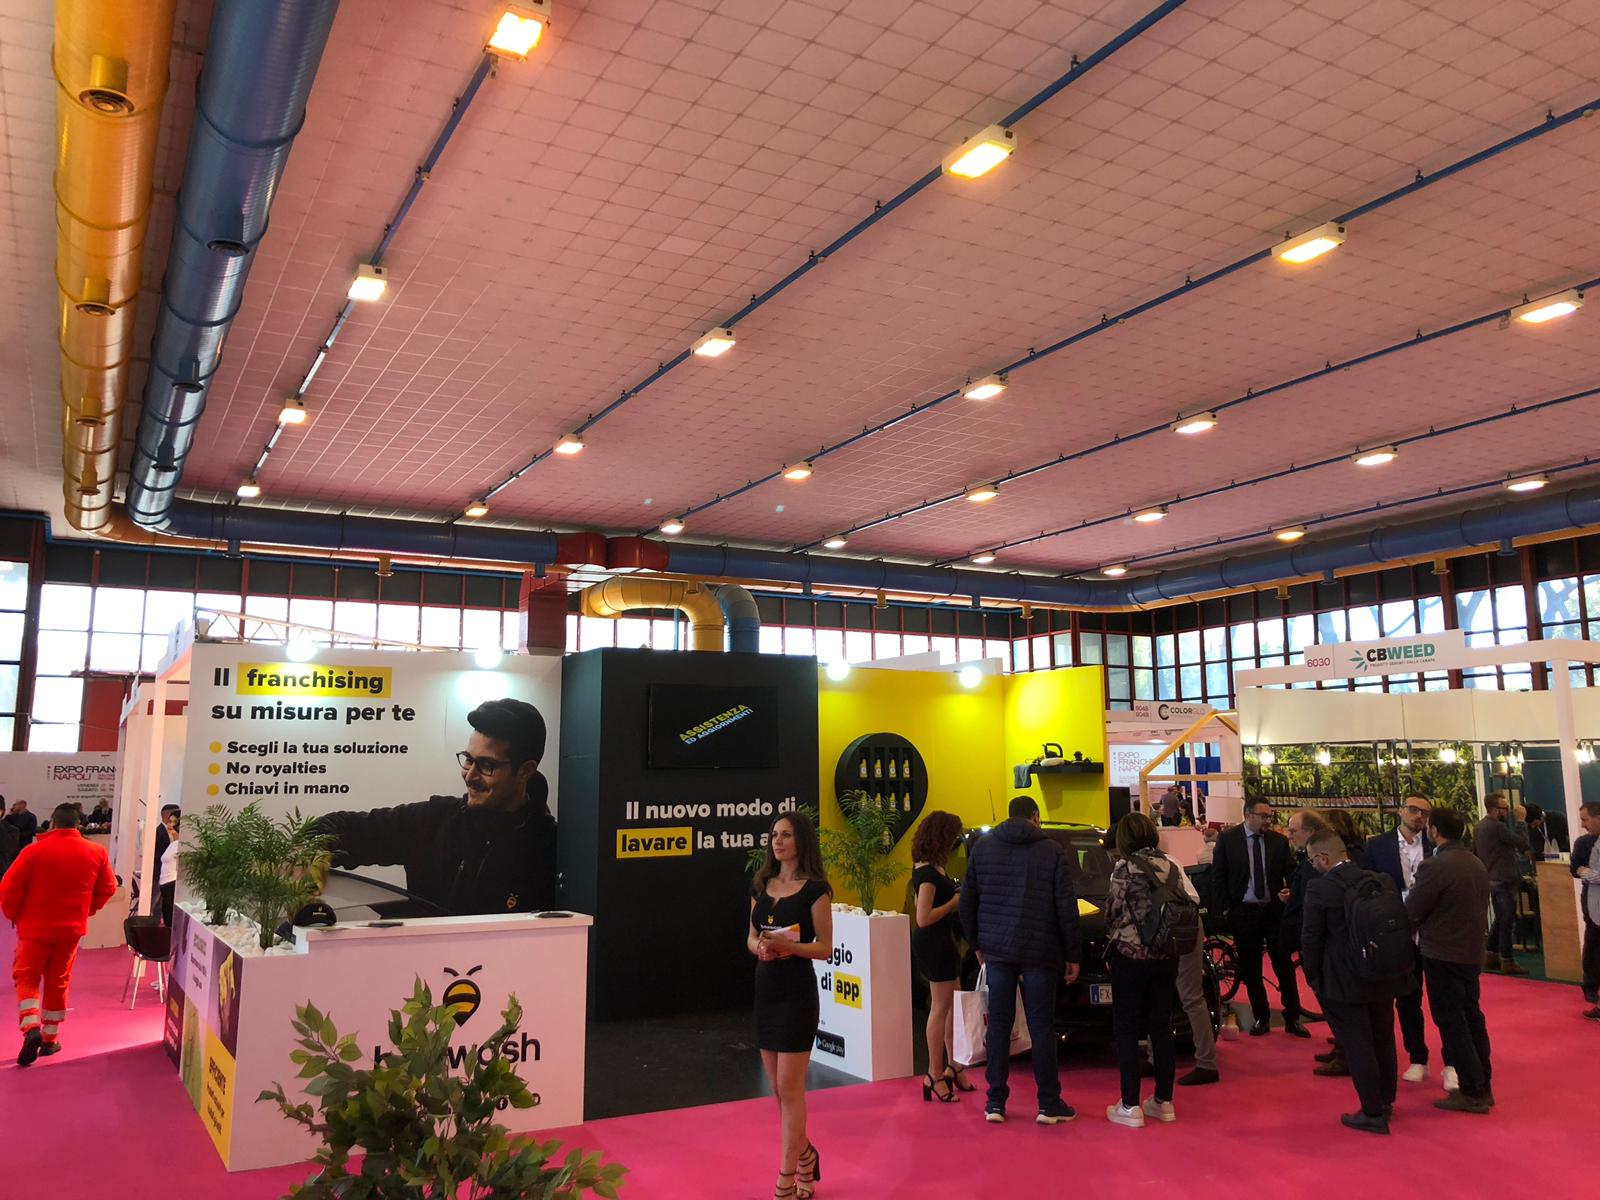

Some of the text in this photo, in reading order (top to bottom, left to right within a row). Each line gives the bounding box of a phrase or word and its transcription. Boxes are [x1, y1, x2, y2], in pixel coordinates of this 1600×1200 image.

[1366, 643, 1436, 662] CBWEED
[1307, 657, 1330, 668] 6030
[214, 668, 384, 694] Il franchising
[211, 701, 416, 725] su misura per te
[679, 704, 749, 741] ASSISTENZA
[227, 741, 409, 757] Scegli la tua soluzione
[685, 736, 697, 745] ED
[54, 765, 116, 773] EXPO FRAN
[226, 761, 327, 777] No royalties
[225, 782, 350, 795] Chiavi in mano
[625, 796, 796, 820] Il nuovo modo di
[622, 834, 687, 852] lavare
[697, 831, 715, 849] la
[720, 831, 754, 848] tua
[821, 972, 860, 1002] di app
